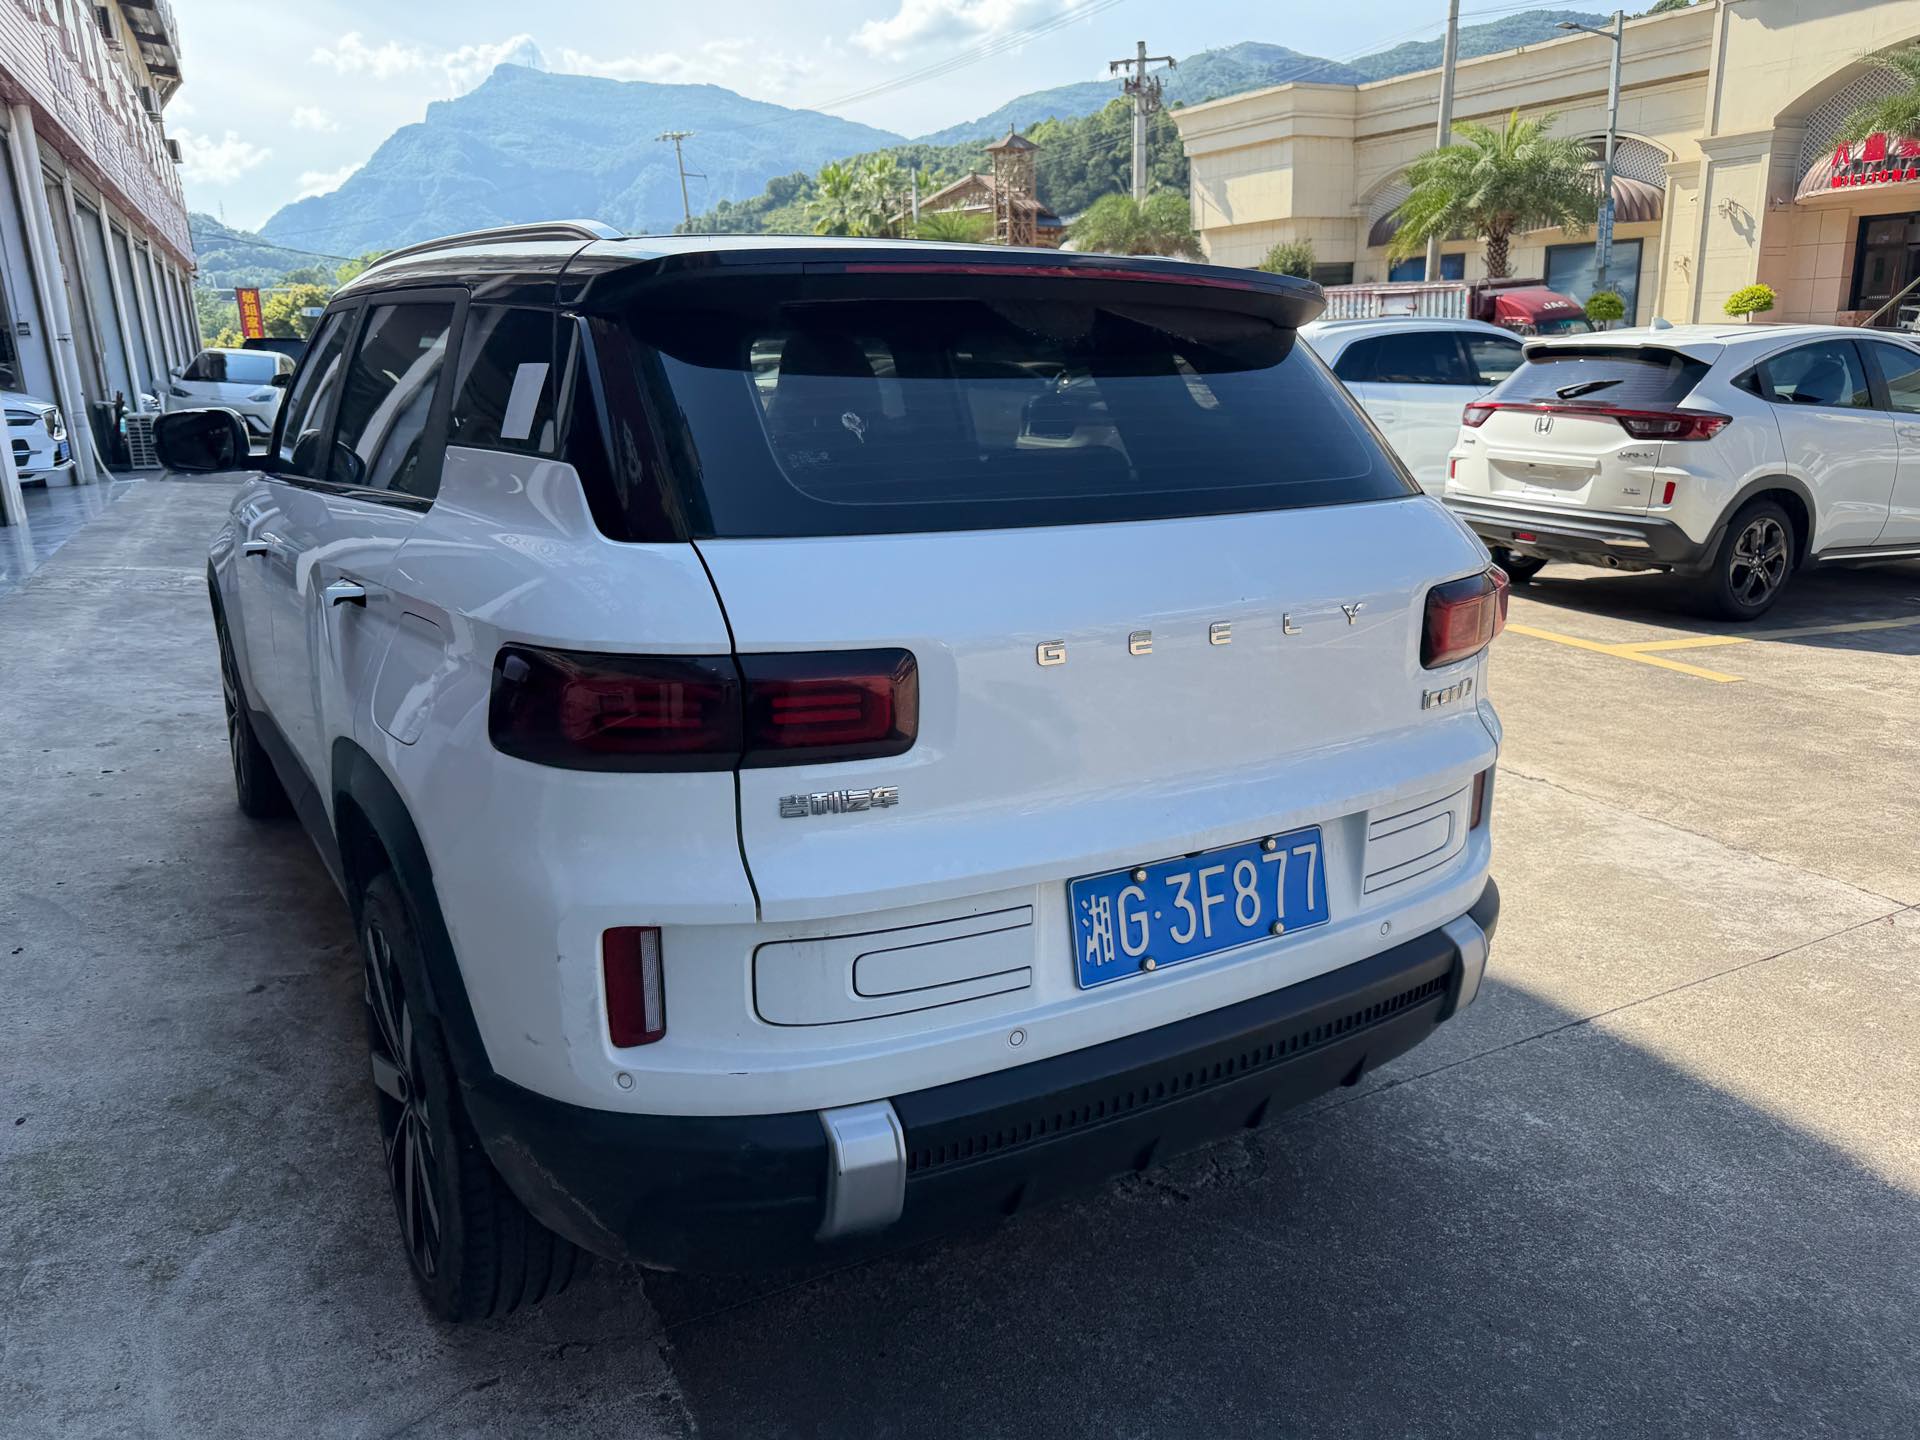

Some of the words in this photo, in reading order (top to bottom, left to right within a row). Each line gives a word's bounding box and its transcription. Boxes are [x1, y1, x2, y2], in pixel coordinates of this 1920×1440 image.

[1036, 601, 1366, 667] GEELY
[779, 785, 899, 818] 吉利汽车
